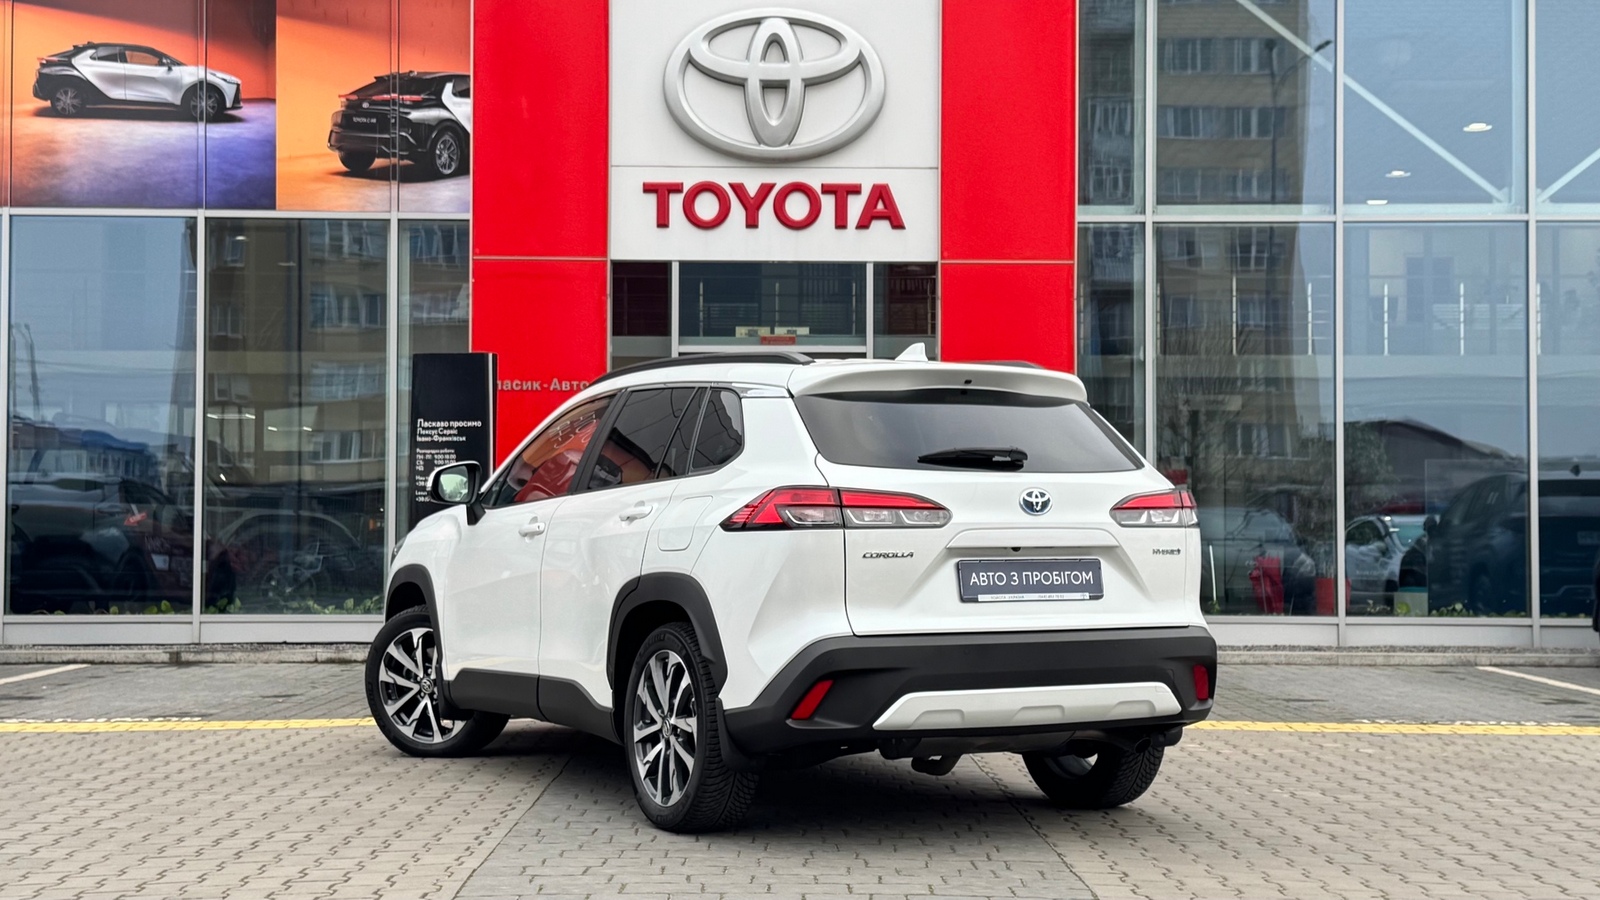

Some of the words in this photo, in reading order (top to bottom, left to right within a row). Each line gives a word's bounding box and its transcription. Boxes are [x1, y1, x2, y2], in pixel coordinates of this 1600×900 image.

[642, 180, 907, 231] TOYOTA
[417, 418, 449, 428] Ласкаво
[450, 420, 482, 428] просимо
[862, 551, 914, 559] COROLLA
[970, 572, 1007, 586] АВТО
[1022, 571, 1094, 586] ПРОБІГОМ
